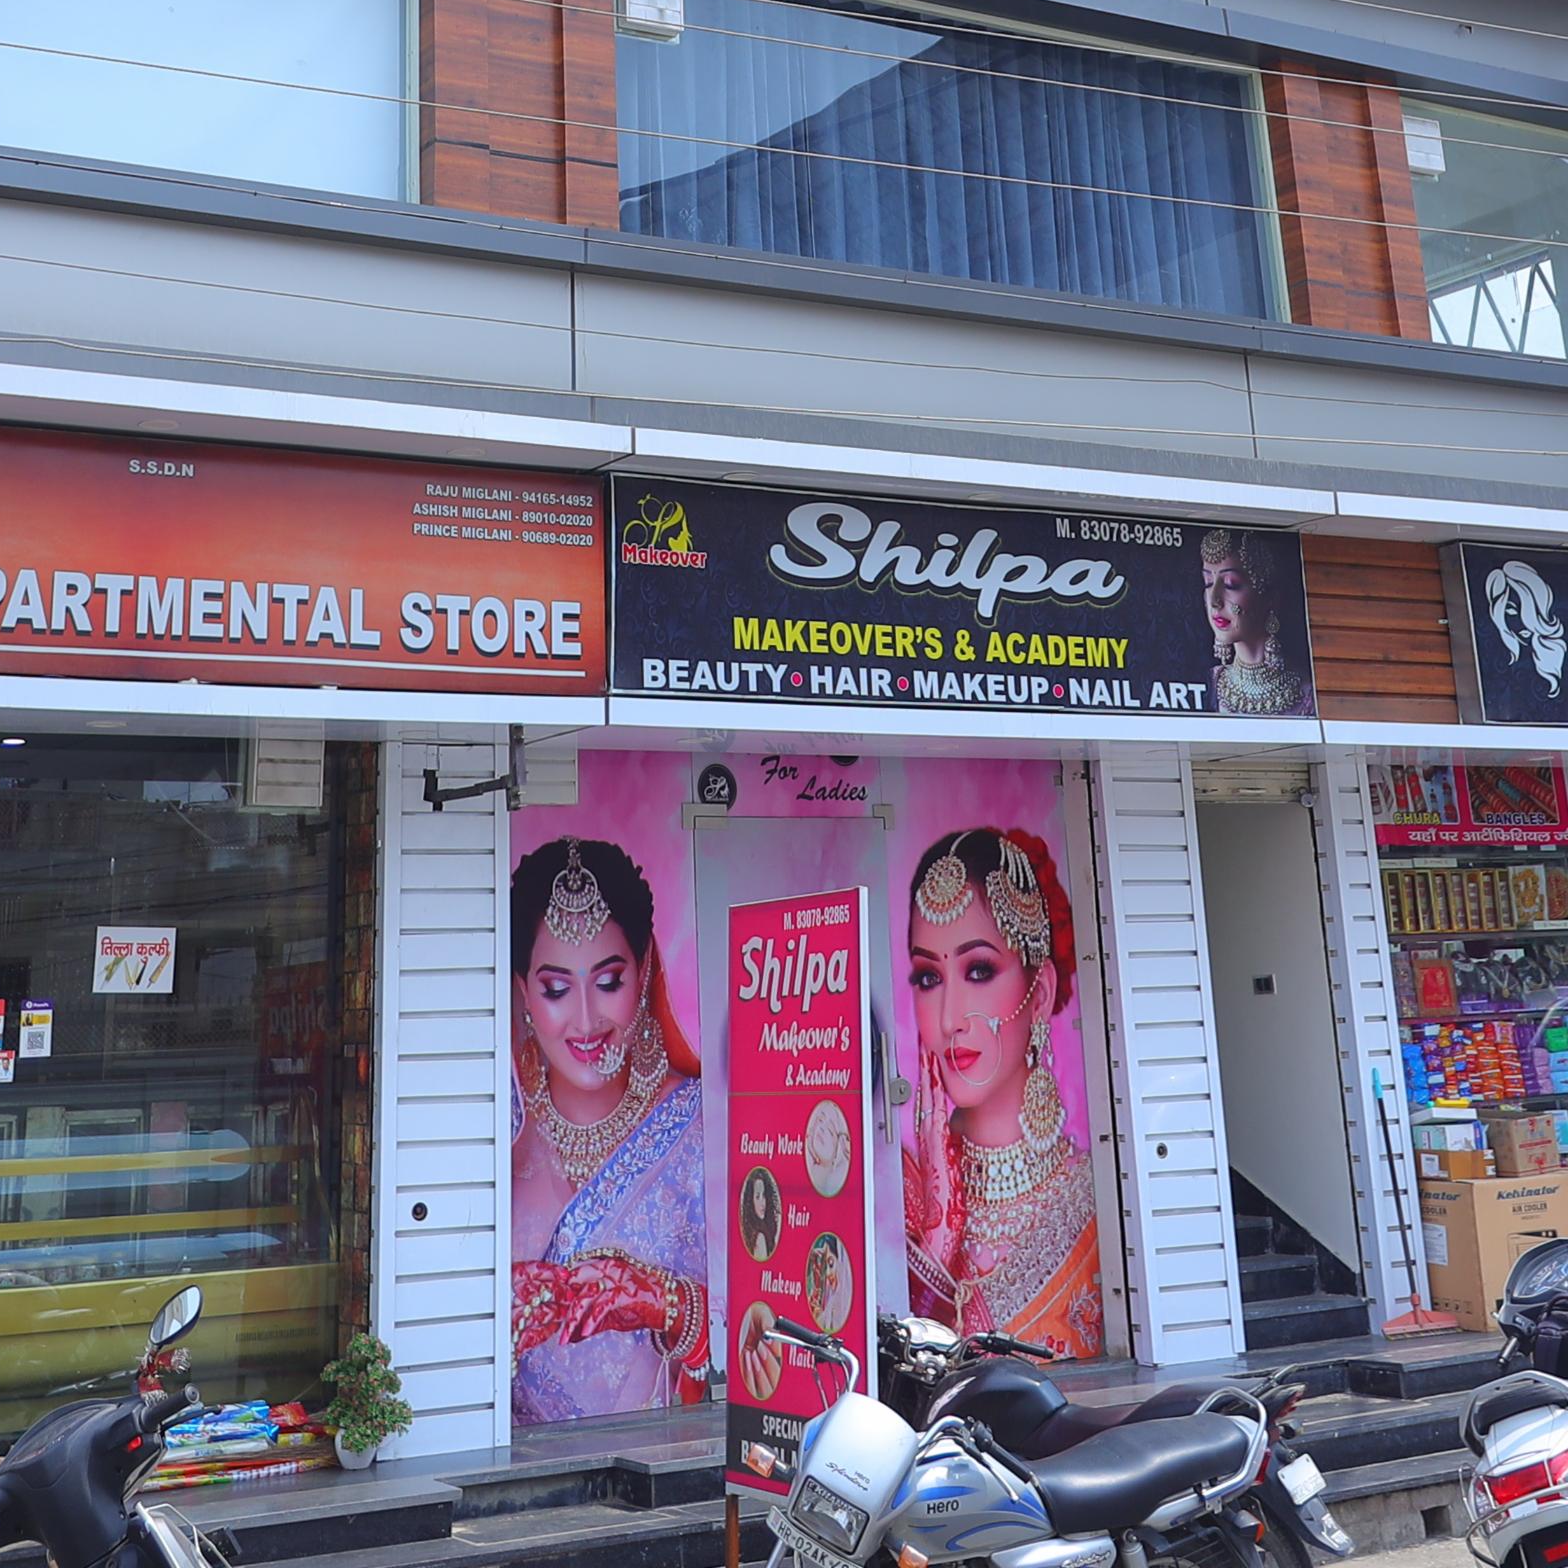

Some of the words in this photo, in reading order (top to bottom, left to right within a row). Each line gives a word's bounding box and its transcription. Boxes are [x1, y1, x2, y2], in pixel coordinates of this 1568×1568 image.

[129, 458, 196, 478] S.S.D.N
[426, 484, 459, 498] RAJU
[461, 487, 512, 502] MIGLANI
[522, 491, 593, 508] 94165-14952
[412, 503, 459, 518] ASHISH
[461, 506, 512, 522] MIGLANI
[522, 510, 593, 528] 89010-02020
[412, 523, 459, 538] PRINCE
[461, 526, 512, 542] MIGLANI
[522, 530, 593, 547] 90689-02020
[1056, 517, 1078, 540] M.
[1080, 519, 1183, 549] 83078-92865
[622, 542, 707, 569] Makeover
[767, 501, 1127, 622] Shilpa
[399, 590, 583, 659] STORE
[733, 617, 944, 661] MAKEOVER'S
[954, 632, 976, 662] &
[986, 633, 1129, 670] ACADEMY
[642, 658, 788, 694] BEAUTY
[810, 666, 894, 698] HAIR
[914, 672, 1050, 705] MAKEUP
[1069, 679, 1141, 710] NAIL
[1149, 681, 1207, 711] ART
[760, 754, 800, 786] For
[796, 775, 869, 802] Ladies
[1393, 812, 1441, 825] CHURA
[1487, 813, 1545, 825] BANGLES
[1440, 831, 1459, 842] पर
[783, 911, 795, 931] M.
[795, 903, 851, 930] 83078-92865
[135, 937, 170, 964] कुल्फी
[738, 933, 849, 1014] Shilpa
[758, 1015, 850, 1057] Makeover's
[785, 1066, 795, 1087] &
[795, 1061, 851, 1090] Academy
[740, 1132, 775, 1159] Beauty
[777, 1133, 804, 1156] Work
[786, 1203, 812, 1229] Hair
[1511, 1202, 1523, 1213] AIR
[1523, 1200, 1548, 1213] COOLER
[760, 1269, 802, 1301] Makeup
[926, 1499, 960, 1515] Hero
